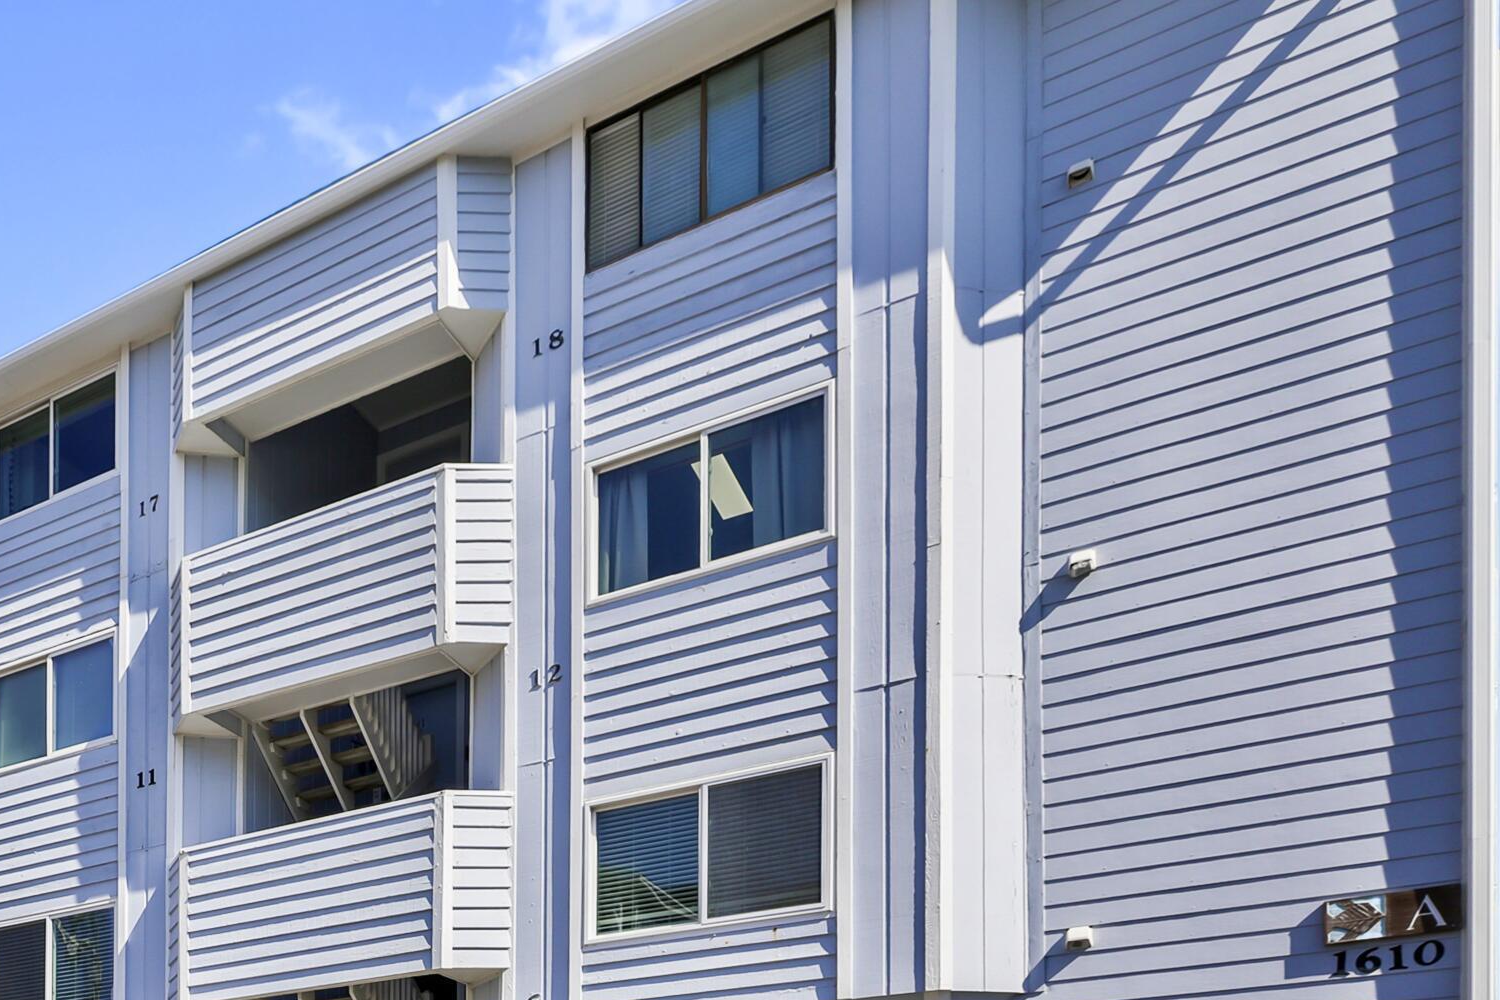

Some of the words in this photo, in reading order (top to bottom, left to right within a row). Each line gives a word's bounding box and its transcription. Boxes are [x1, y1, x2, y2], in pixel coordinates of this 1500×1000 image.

[532, 328, 564, 358] 18
[139, 493, 159, 518] 17
[529, 664, 563, 692] 12
[136, 768, 156, 789] 11
[1406, 894, 1447, 931] A
[1329, 939, 1446, 979] 1610
